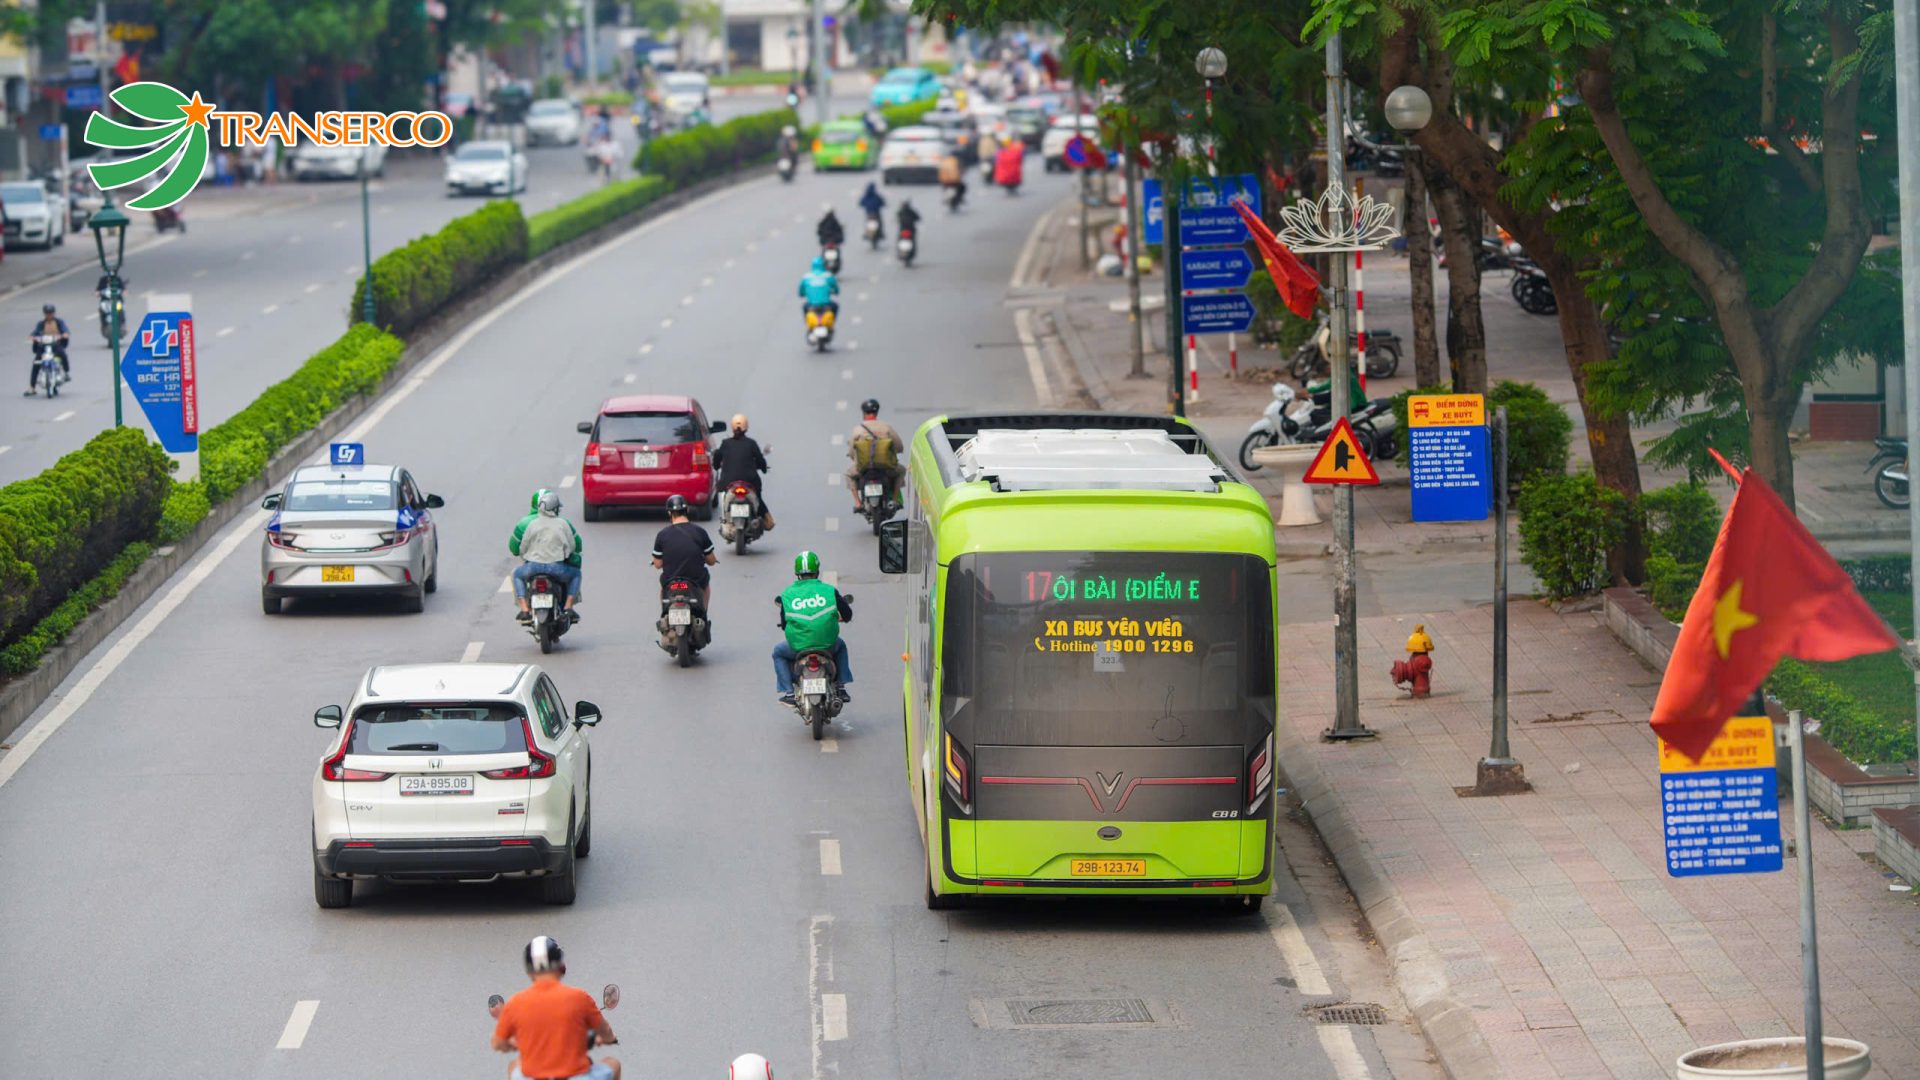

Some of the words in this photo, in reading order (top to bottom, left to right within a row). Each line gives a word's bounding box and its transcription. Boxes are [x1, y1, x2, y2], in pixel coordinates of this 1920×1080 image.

[183, 324, 193, 380] EMERGENCY
[186, 384, 195, 430] HOSPITAL
[338, 445, 356, 462] G7
[1084, 575, 1116, 600] BÀI
[1125, 571, 1182, 601] (ĐIỂM
[791, 595, 826, 611] Grab
[1074, 619, 1103, 637] BUS
[1050, 639, 1098, 653] Hotline
[1104, 640, 1146, 653] 1900
[1152, 640, 1194, 653] 1296
[406, 778, 467, 790] 29A-895.08
[349, 804, 373, 812] CR-V
[1078, 862, 1139, 874] 29B-123.74
